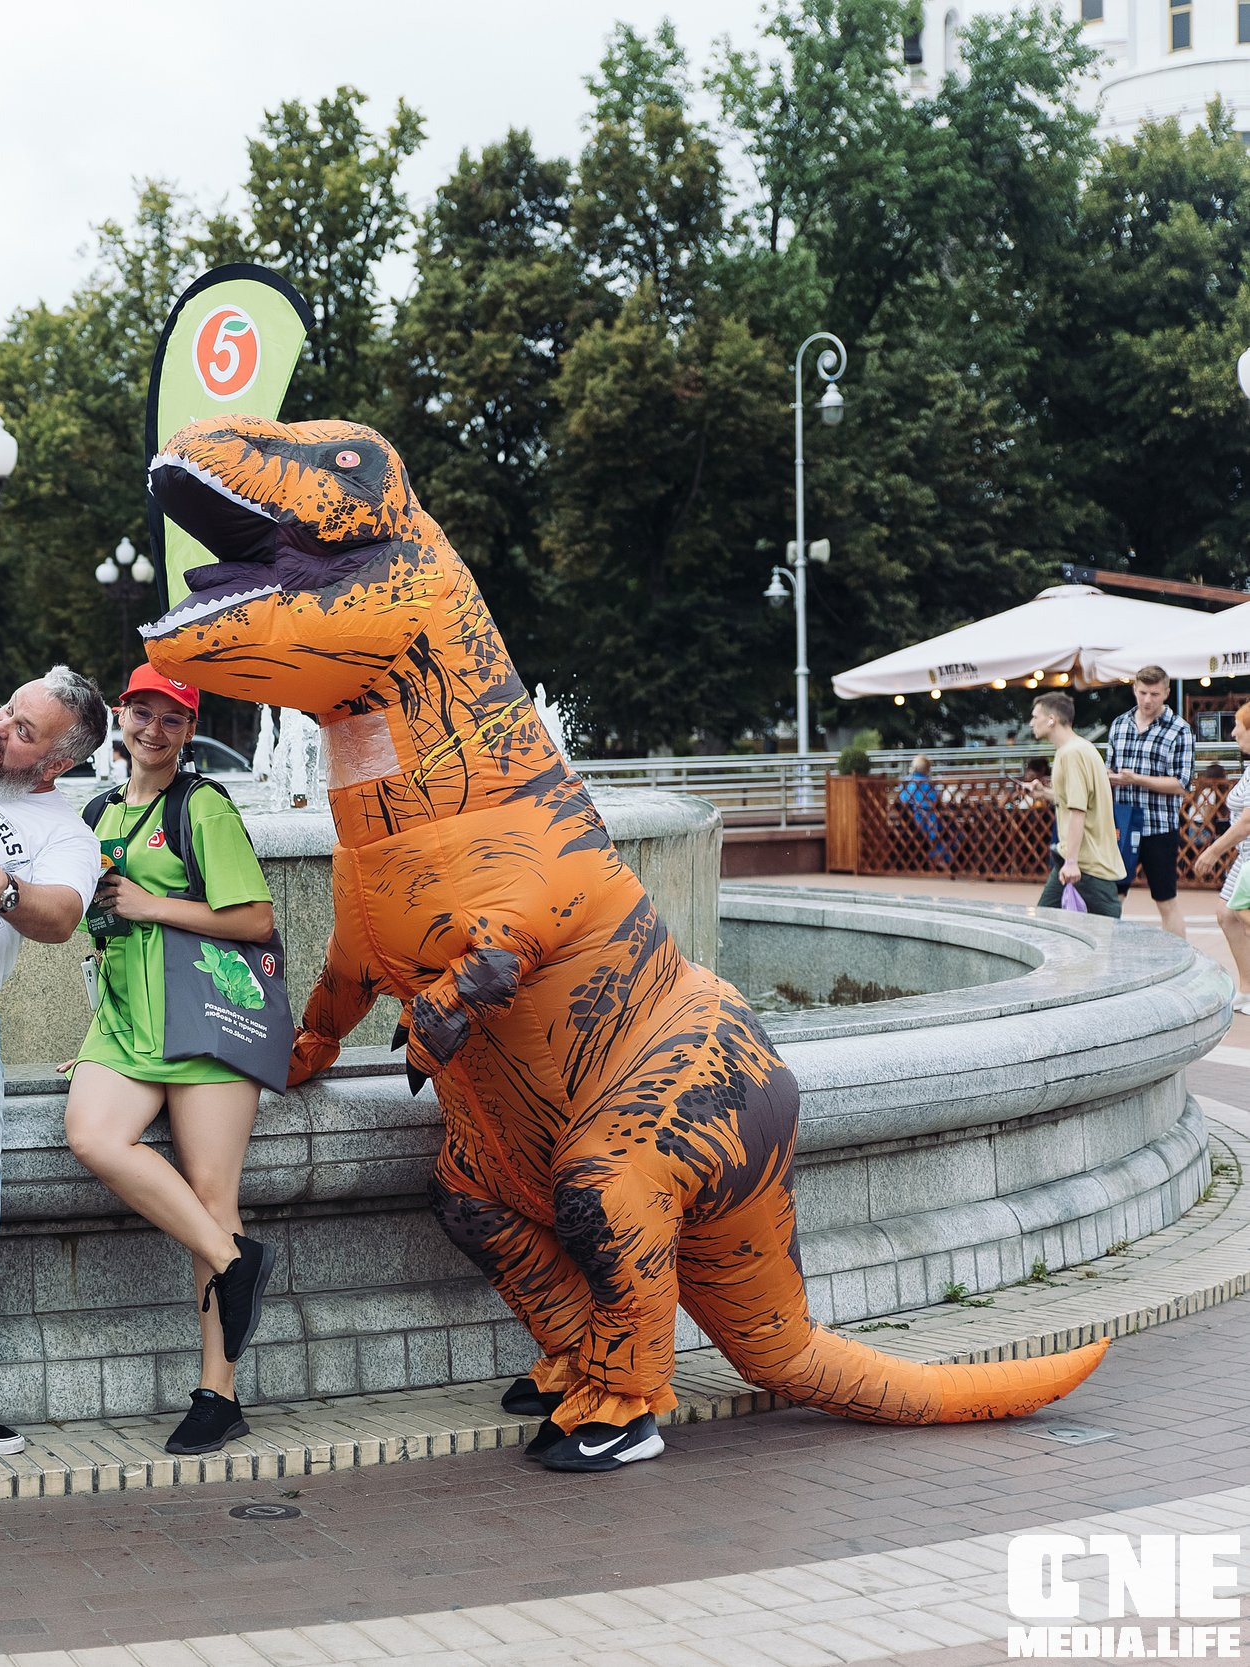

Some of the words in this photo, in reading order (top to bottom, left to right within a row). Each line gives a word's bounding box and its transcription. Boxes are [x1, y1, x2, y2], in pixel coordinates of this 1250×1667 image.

[208, 315, 252, 383] 5
[204, 1002, 245, 1022] разделяйте
[250, 1020, 268, 1032] нами
[204, 1011, 233, 1023] любовь
[238, 1021, 268, 1039] природе
[221, 1025, 253, 1044] eco.5ka.ru
